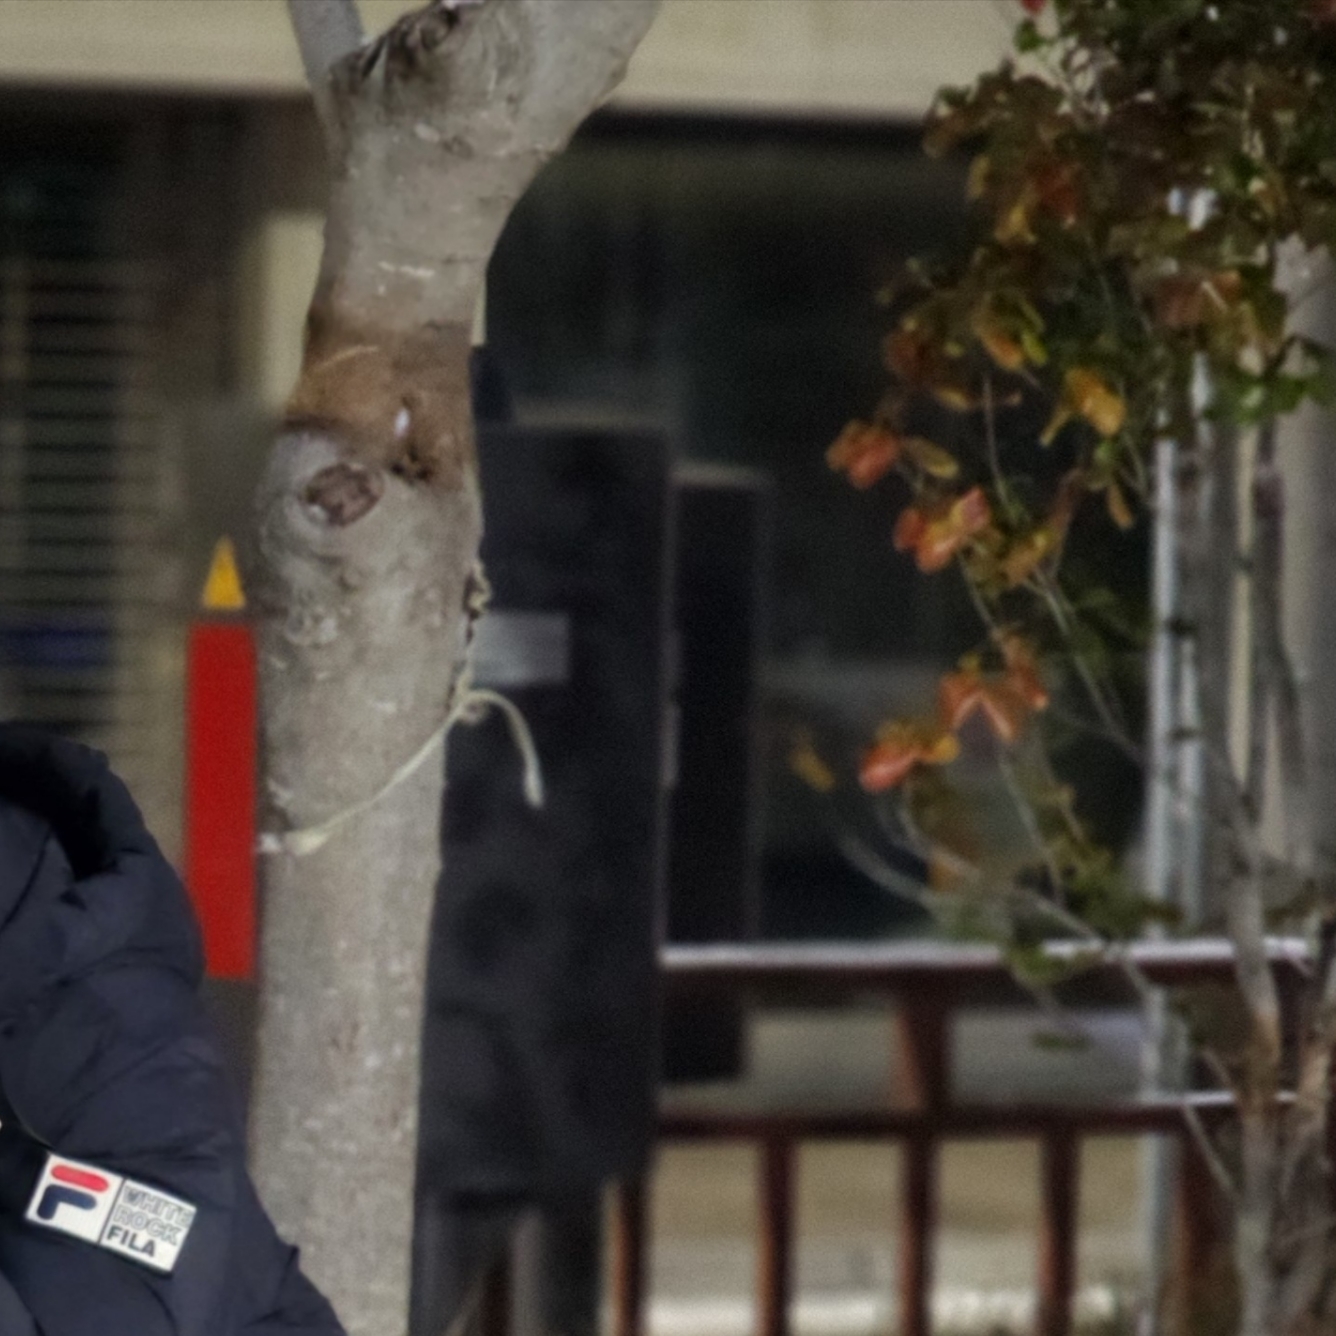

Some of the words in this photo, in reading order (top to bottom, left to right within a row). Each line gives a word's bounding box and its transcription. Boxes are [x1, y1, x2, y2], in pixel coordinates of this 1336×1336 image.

[113, 1204, 181, 1246] ROCK
[124, 1186, 192, 1228] WHITE
[107, 1225, 155, 1257] FILA
